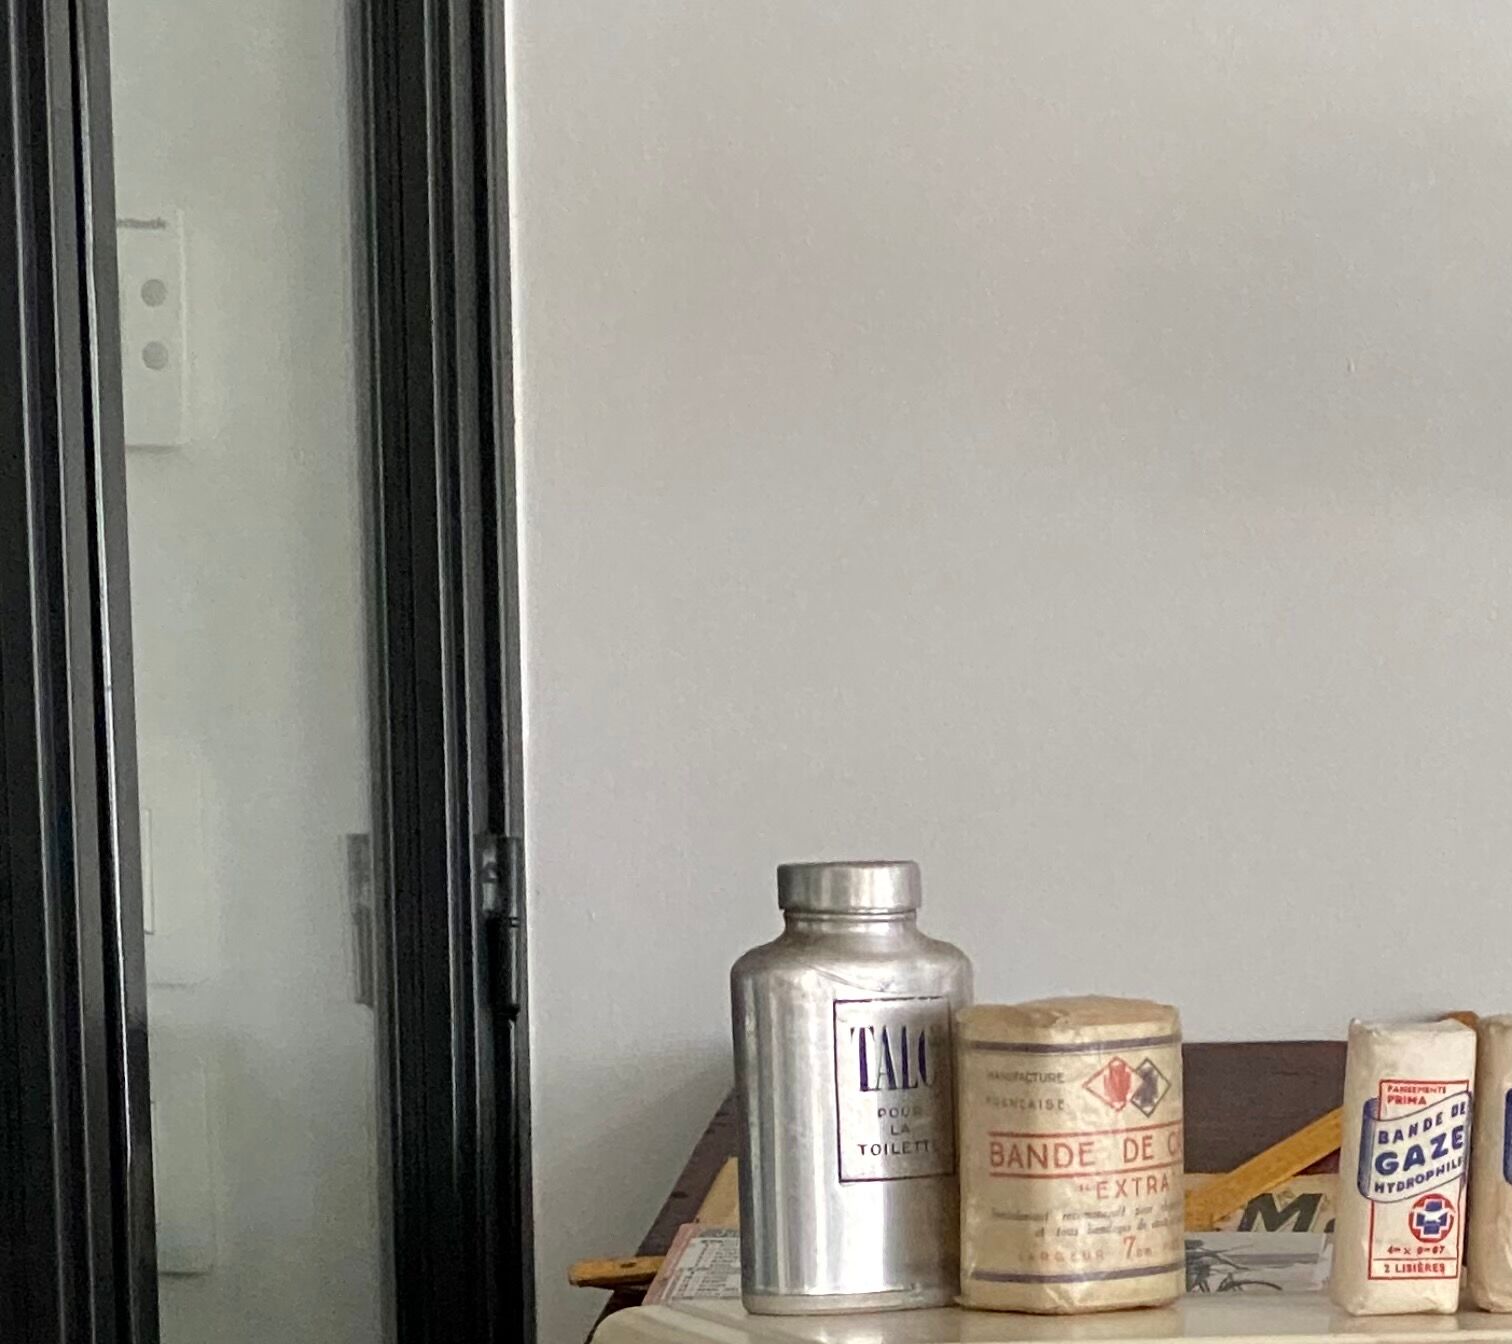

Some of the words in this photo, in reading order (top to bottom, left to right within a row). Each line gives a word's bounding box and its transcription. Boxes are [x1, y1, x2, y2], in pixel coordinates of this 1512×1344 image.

[1387, 1095, 1427, 1105] PRIMA
[890, 1124, 911, 1136] LA
[1378, 1112, 1443, 1144] BANDE
[1450, 1101, 1466, 1118] DE
[858, 1139, 942, 1156] TOILETT
[989, 1142, 1096, 1170] BANDE
[1123, 1135, 1154, 1164] DE
[1374, 1125, 1465, 1176] GAZE
[1384, 1264, 1391, 1274] 2
[1395, 1261, 1446, 1275] LISIÈRES
